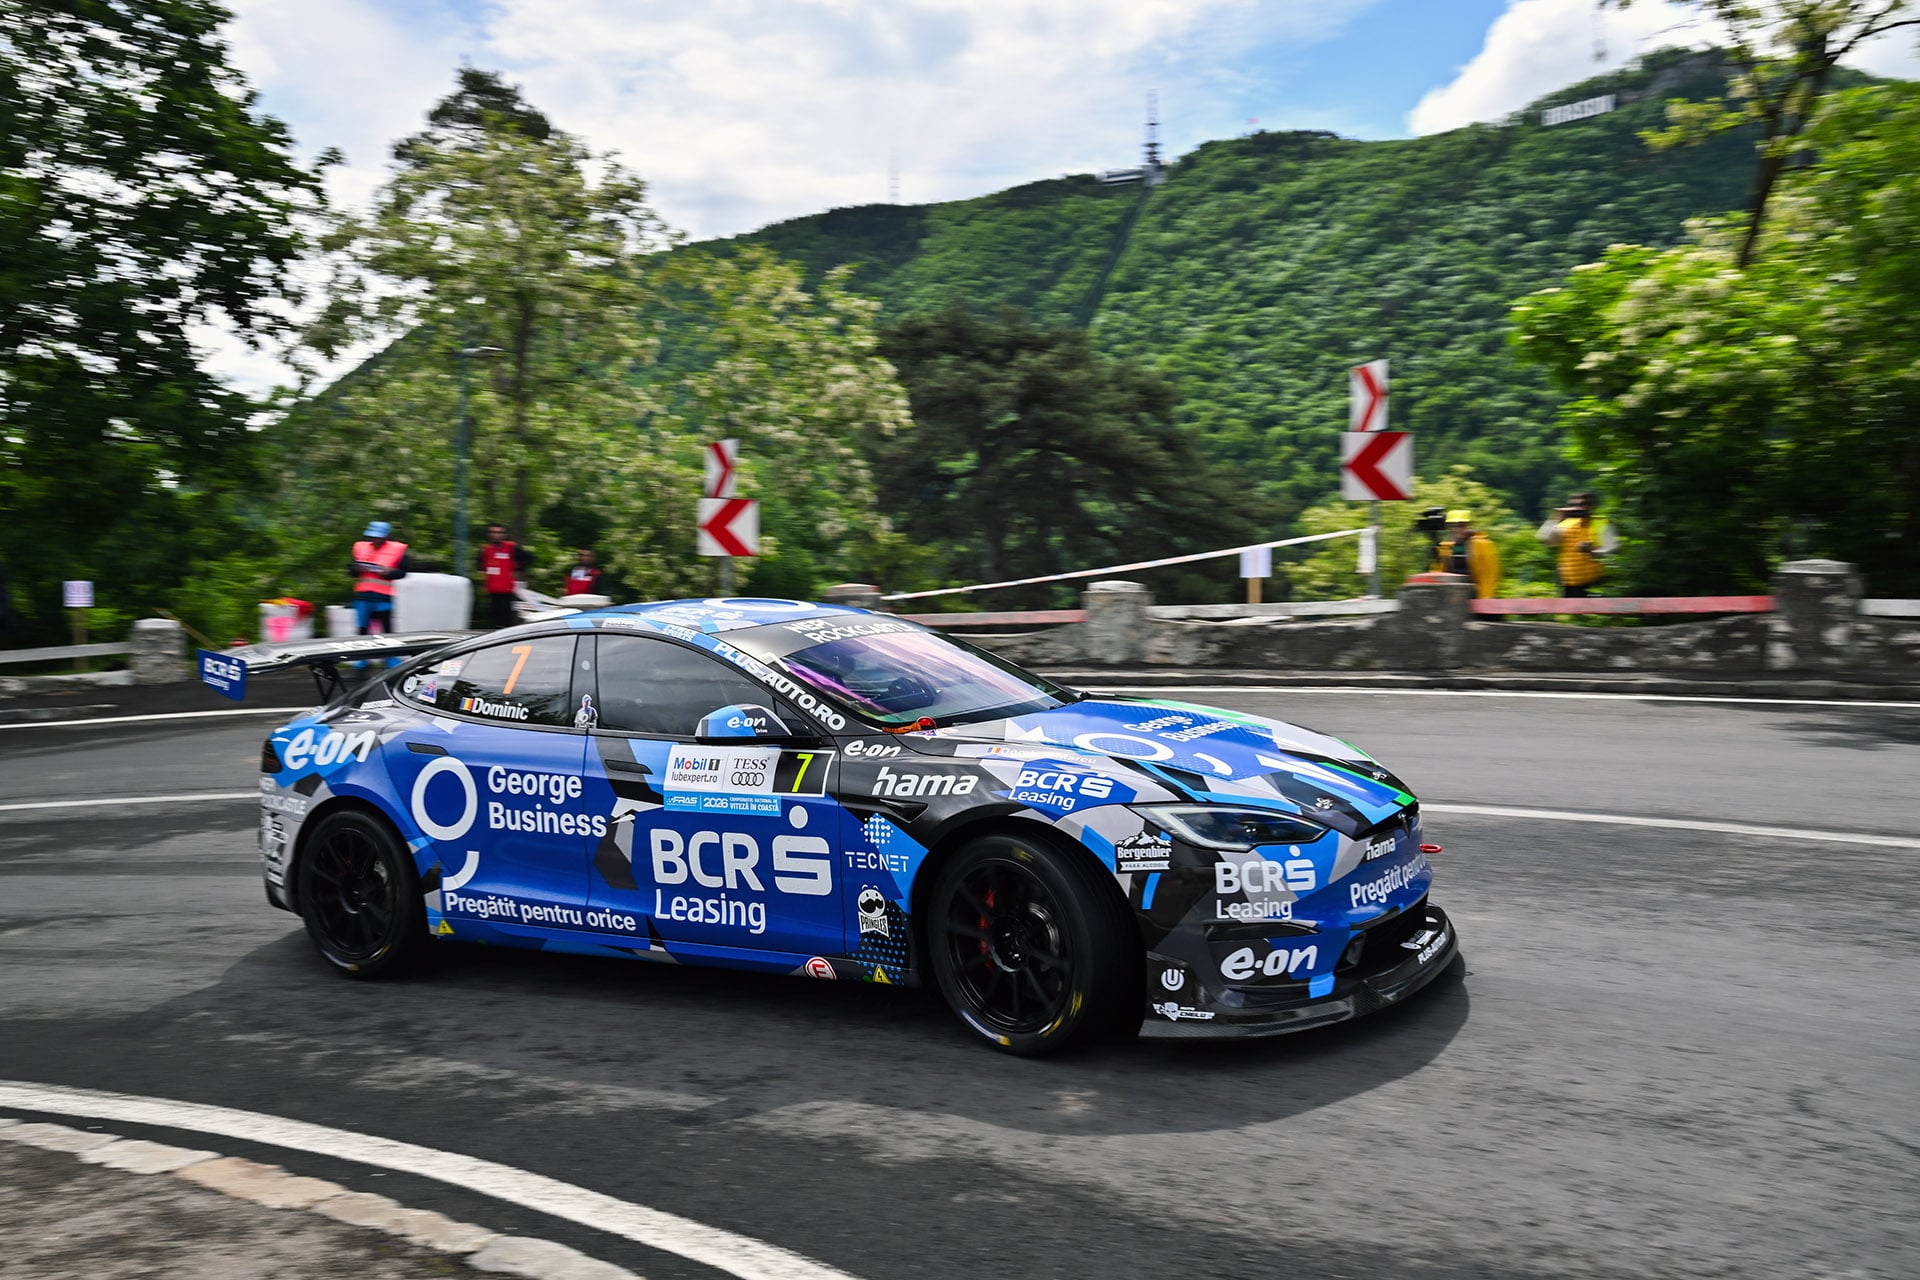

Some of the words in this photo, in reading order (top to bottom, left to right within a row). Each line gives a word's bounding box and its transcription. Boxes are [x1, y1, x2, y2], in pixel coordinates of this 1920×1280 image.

[502, 645, 532, 695] 7
[713, 643, 846, 731] PLUS-AUTO.RO
[472, 697, 529, 720] Dominic
[674, 757, 706, 770] Mobil
[734, 757, 768, 770] TESS
[791, 753, 814, 792] 7
[488, 766, 582, 805] George
[671, 771, 718, 784] lubexpert.ro
[871, 766, 979, 796] hama
[1017, 770, 1078, 793] BCR
[703, 797, 729, 808] 2026
[1008, 788, 1076, 811] Leasing
[488, 802, 607, 838] Business
[650, 828, 766, 892] BCR
[1117, 845, 1172, 860] Bergenbier
[1366, 837, 1396, 861] hama
[845, 851, 909, 873] TECNET
[1215, 860, 1286, 894] BCR
[1350, 863, 1403, 908] Pregătit
[444, 892, 519, 920] Pregătit
[520, 902, 583, 926] pentru
[587, 908, 637, 931] orice
[655, 888, 766, 935] Leasing
[1216, 898, 1292, 920] Leasing
[860, 916, 888, 934] PRINGLES
